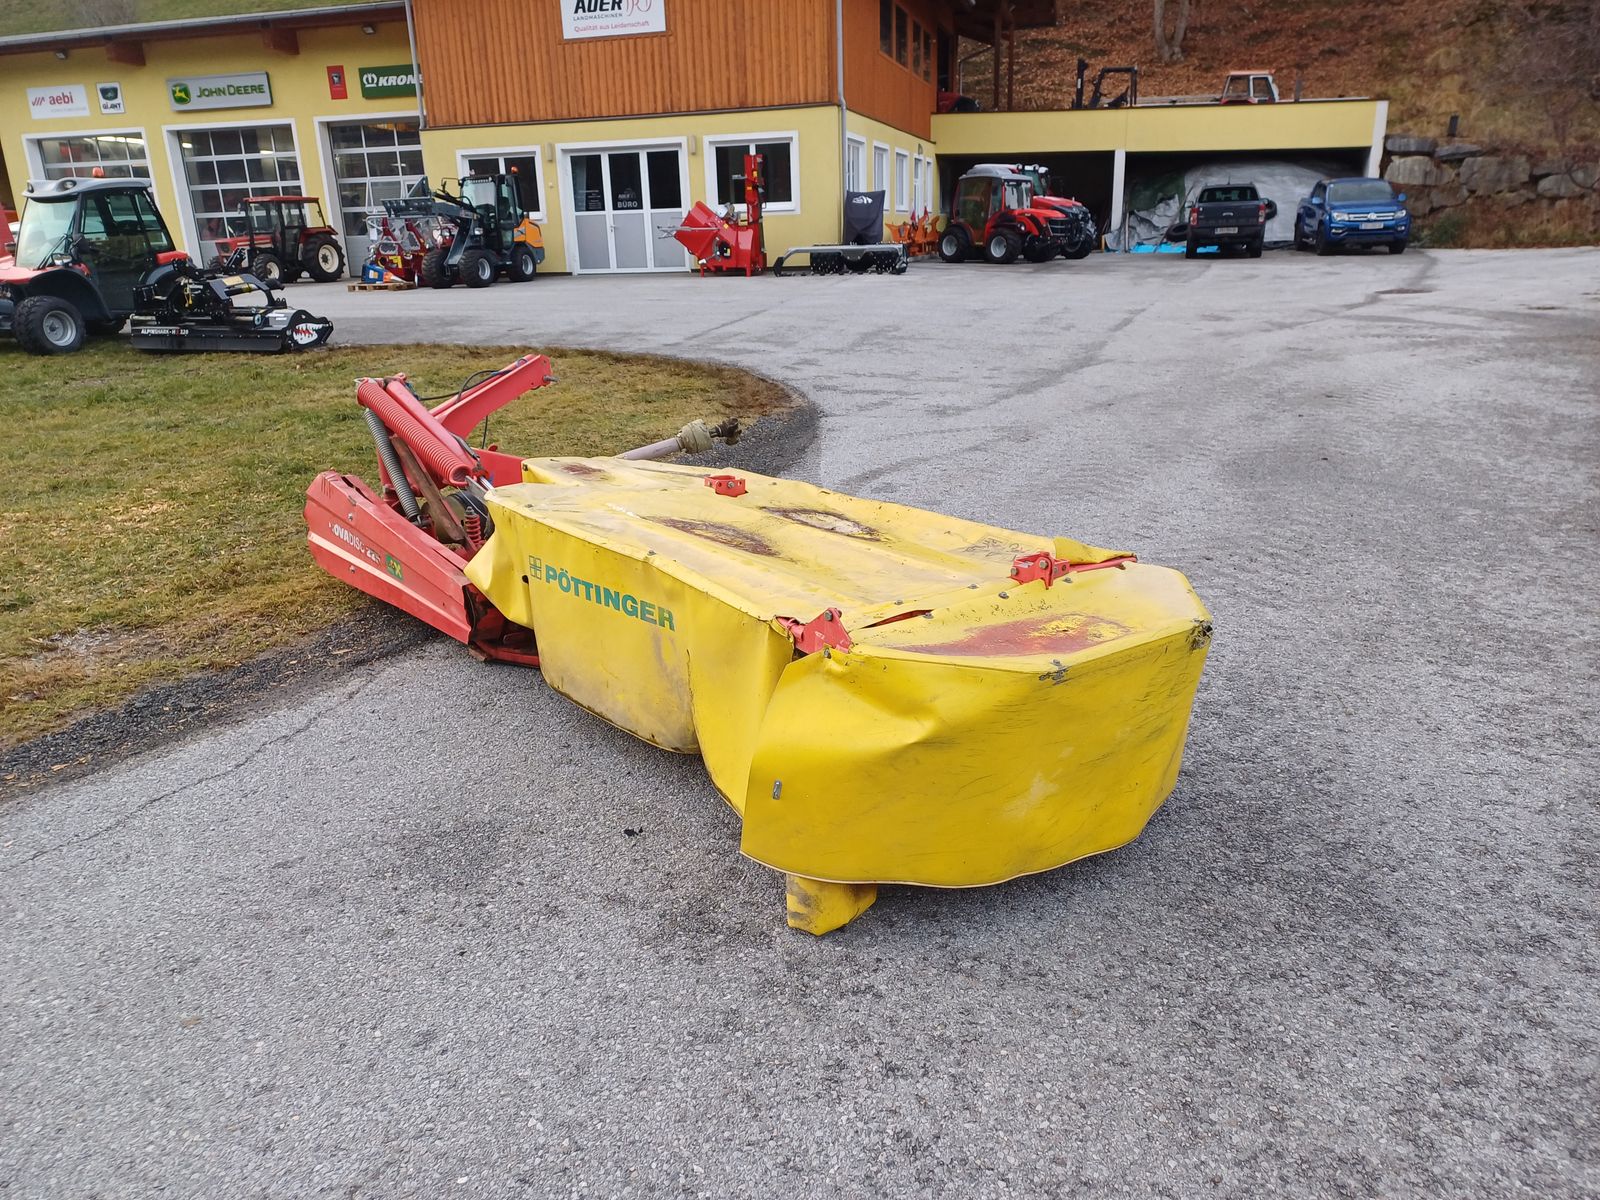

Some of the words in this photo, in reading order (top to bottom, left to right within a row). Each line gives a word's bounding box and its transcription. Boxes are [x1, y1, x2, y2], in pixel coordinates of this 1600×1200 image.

[573, 0, 623, 14] AUER
[573, 13, 623, 21] LANDMASCHINEN
[611, 20, 650, 29] Leidenschaft
[196, 87, 226, 98] JOHN
[227, 84, 266, 95] DEERE
[48, 91, 74, 106] aebi
[617, 199, 638, 208] BÜRO
[328, 521, 366, 554] OVADISC
[545, 564, 675, 632] PÖTTINGER
